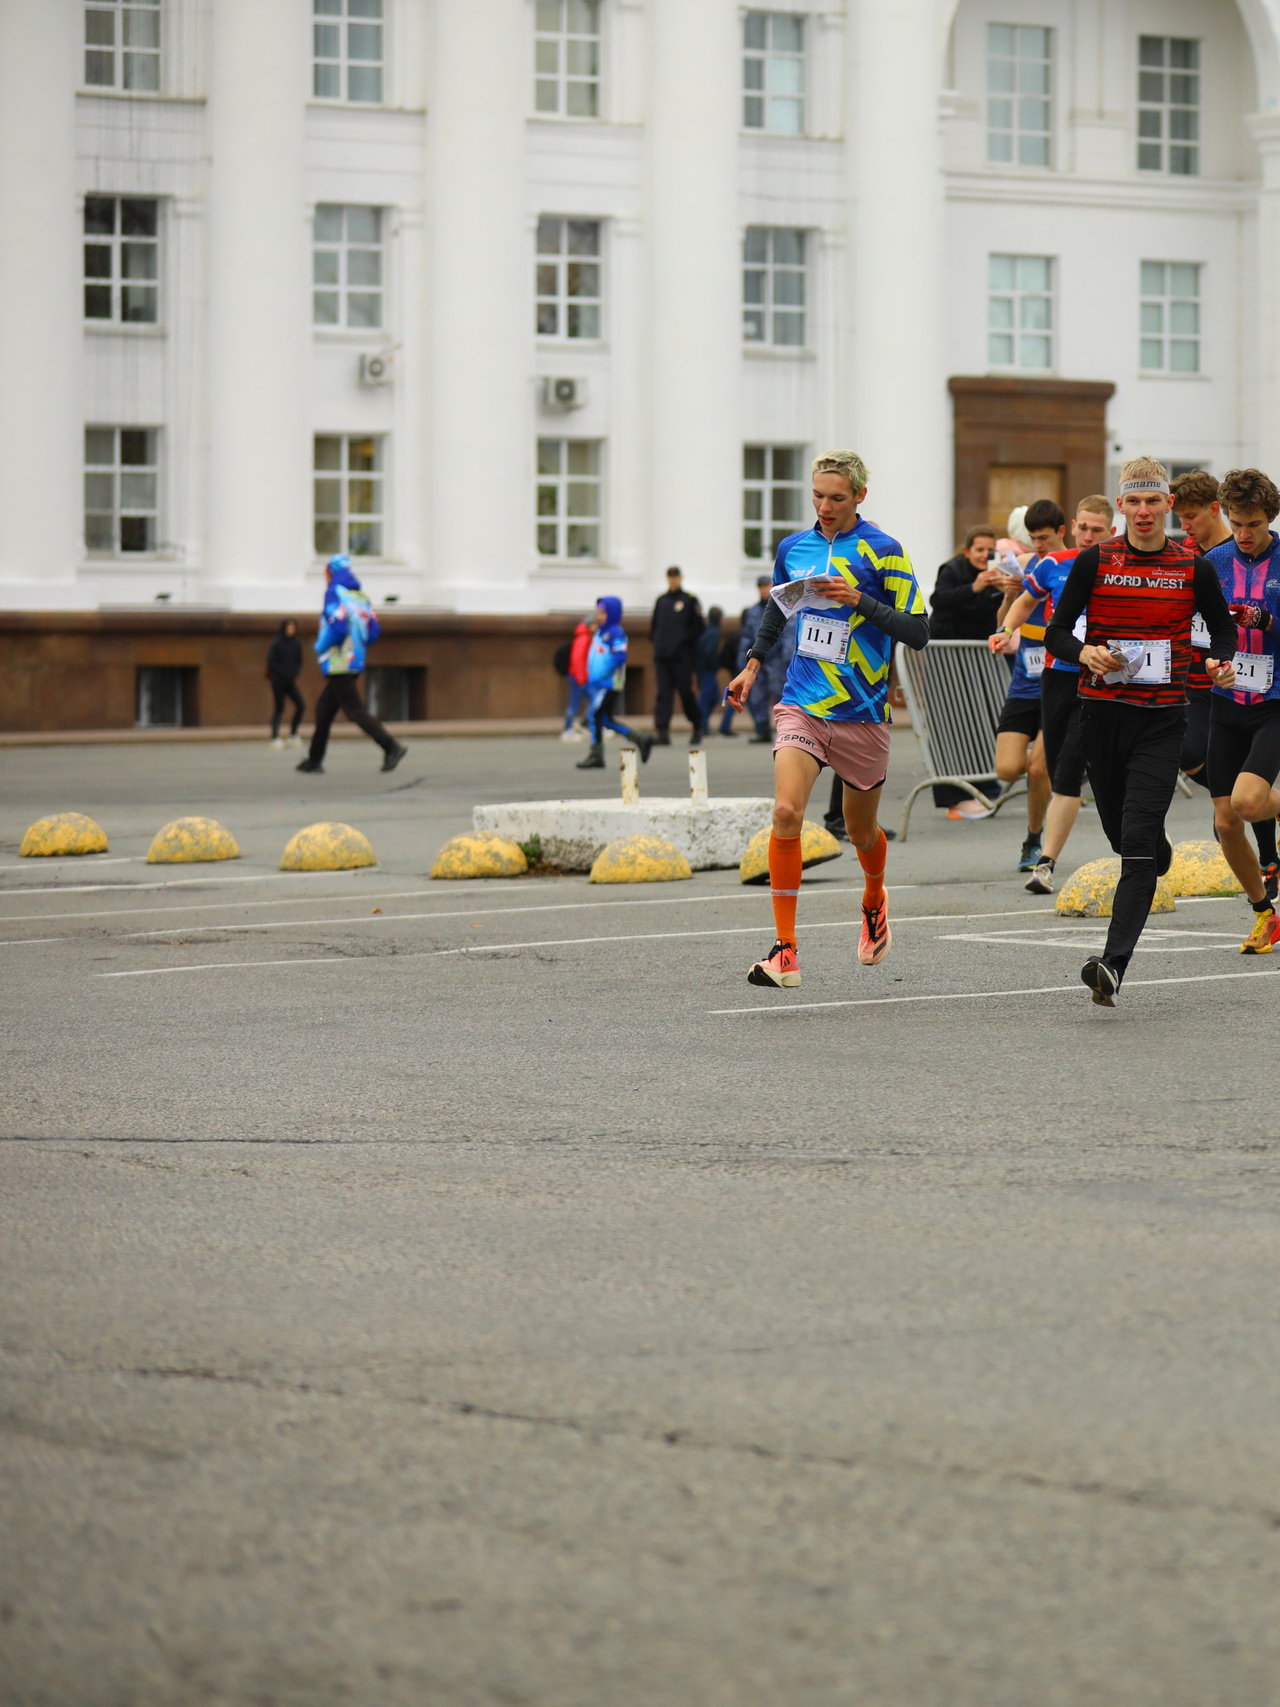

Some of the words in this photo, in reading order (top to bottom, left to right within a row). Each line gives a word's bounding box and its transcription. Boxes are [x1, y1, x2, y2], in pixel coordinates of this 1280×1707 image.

[1123, 481, 1161, 490] noname
[1104, 573, 1142, 587] NORD
[1145, 577, 1186, 590] WEST
[807, 626, 833, 645] 11.1
[1236, 662, 1255, 677] 2.1
